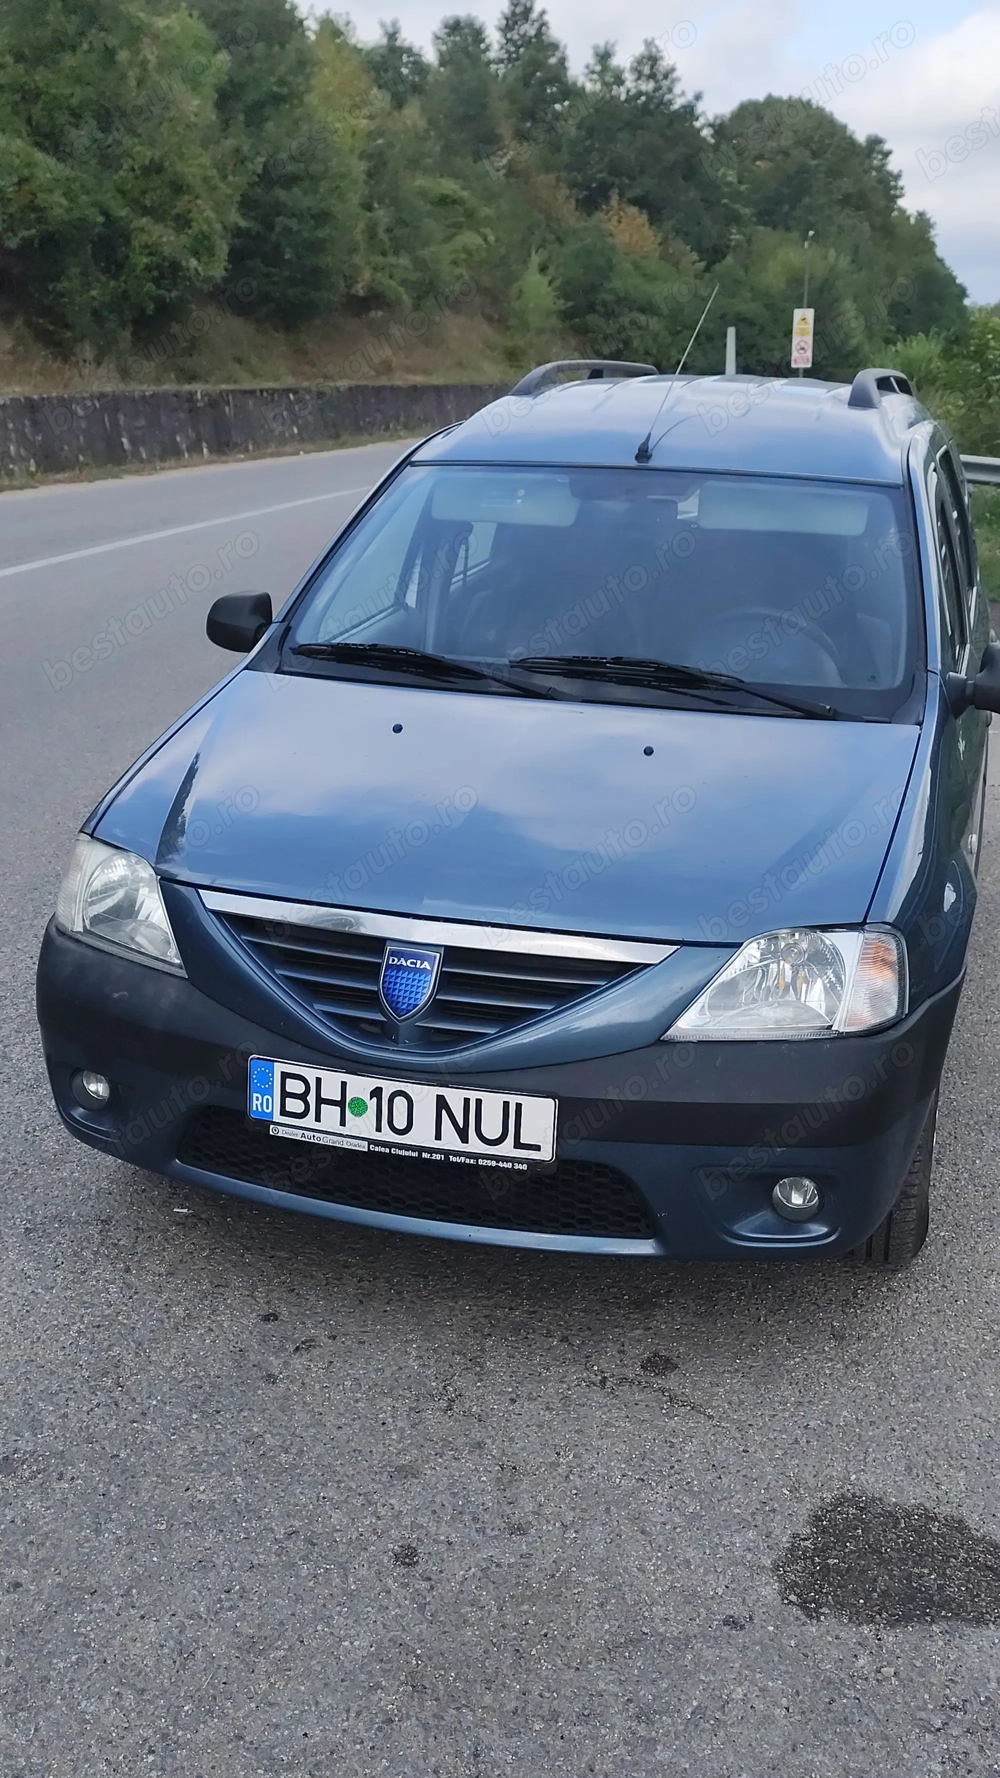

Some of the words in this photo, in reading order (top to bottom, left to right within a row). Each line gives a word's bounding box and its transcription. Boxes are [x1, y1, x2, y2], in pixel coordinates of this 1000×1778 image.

[389, 956, 431, 970] DACIA
[252, 1092, 273, 1113] RO
[279, 1071, 347, 1127] BH
[369, 1086, 414, 1136] 10
[434, 1093, 542, 1152] NUL
[369, 1144, 390, 1154] Calea
[422, 1151, 445, 1161] Nr.201
